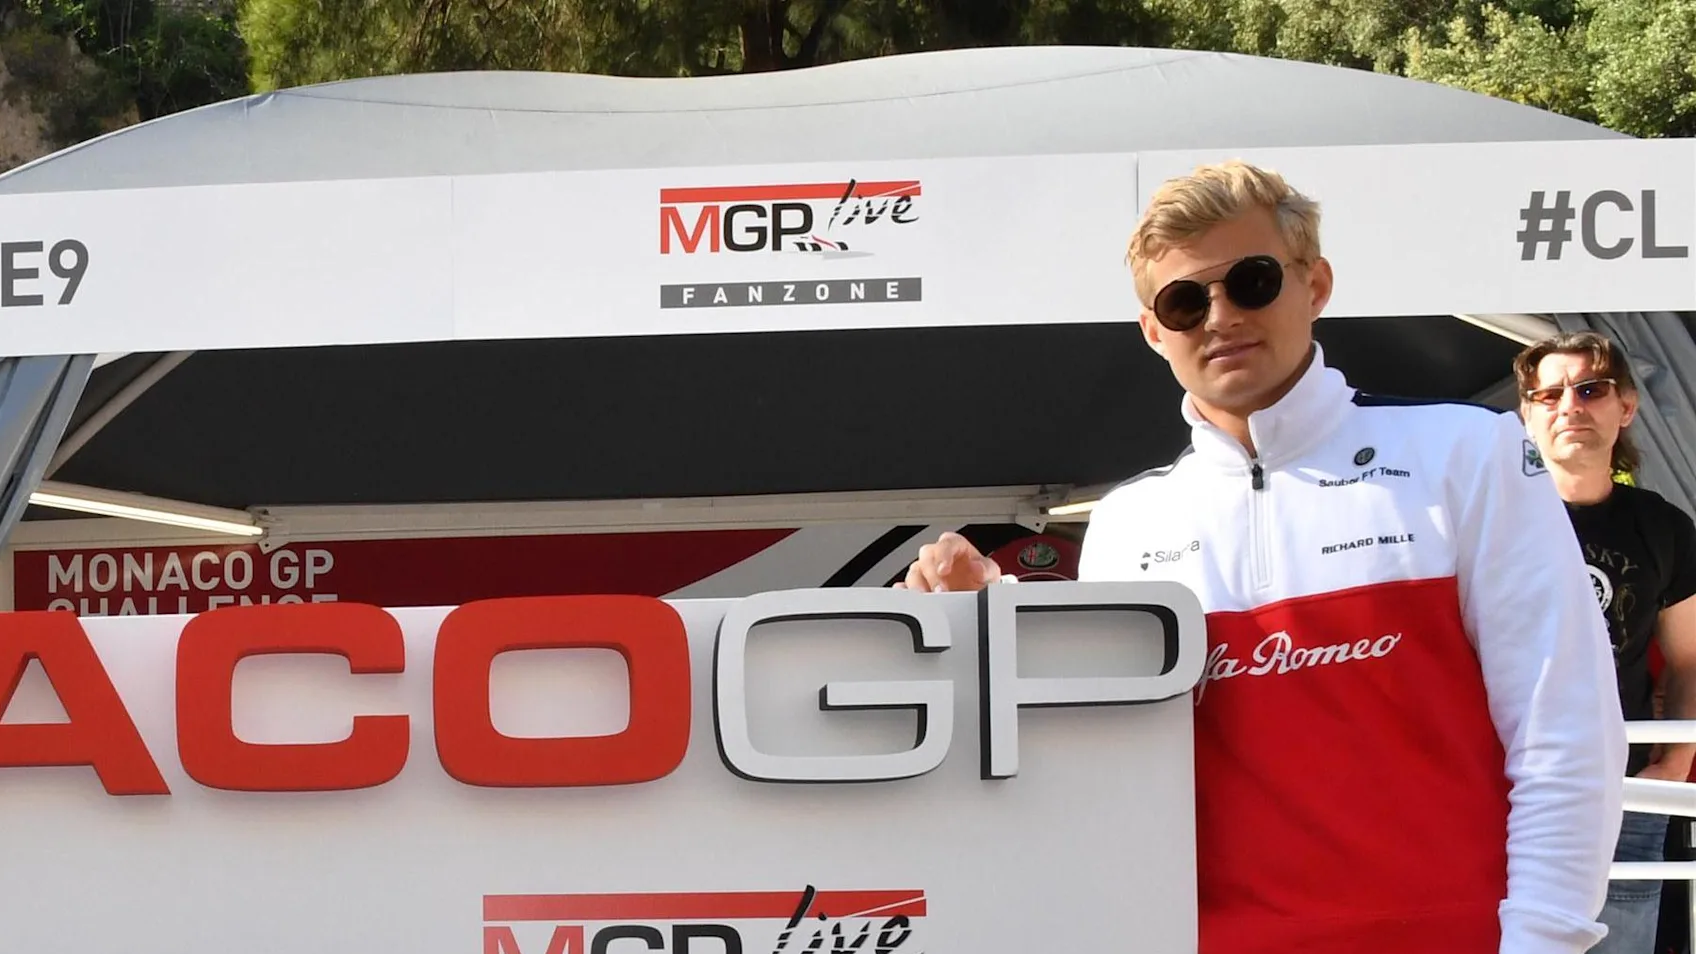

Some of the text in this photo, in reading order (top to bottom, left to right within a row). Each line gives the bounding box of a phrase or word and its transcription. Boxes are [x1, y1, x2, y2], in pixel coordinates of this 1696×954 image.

[660, 178, 921, 254] MGP live
[1516, 189, 1689, 261] #CL
[682, 281, 899, 304] FANZONE
[1378, 466, 1411, 478] Team
[1321, 533, 1415, 555] RICHARD MILLE
[47, 549, 335, 593] MONACO GP
[1248, 630, 1402, 676] Romeo
